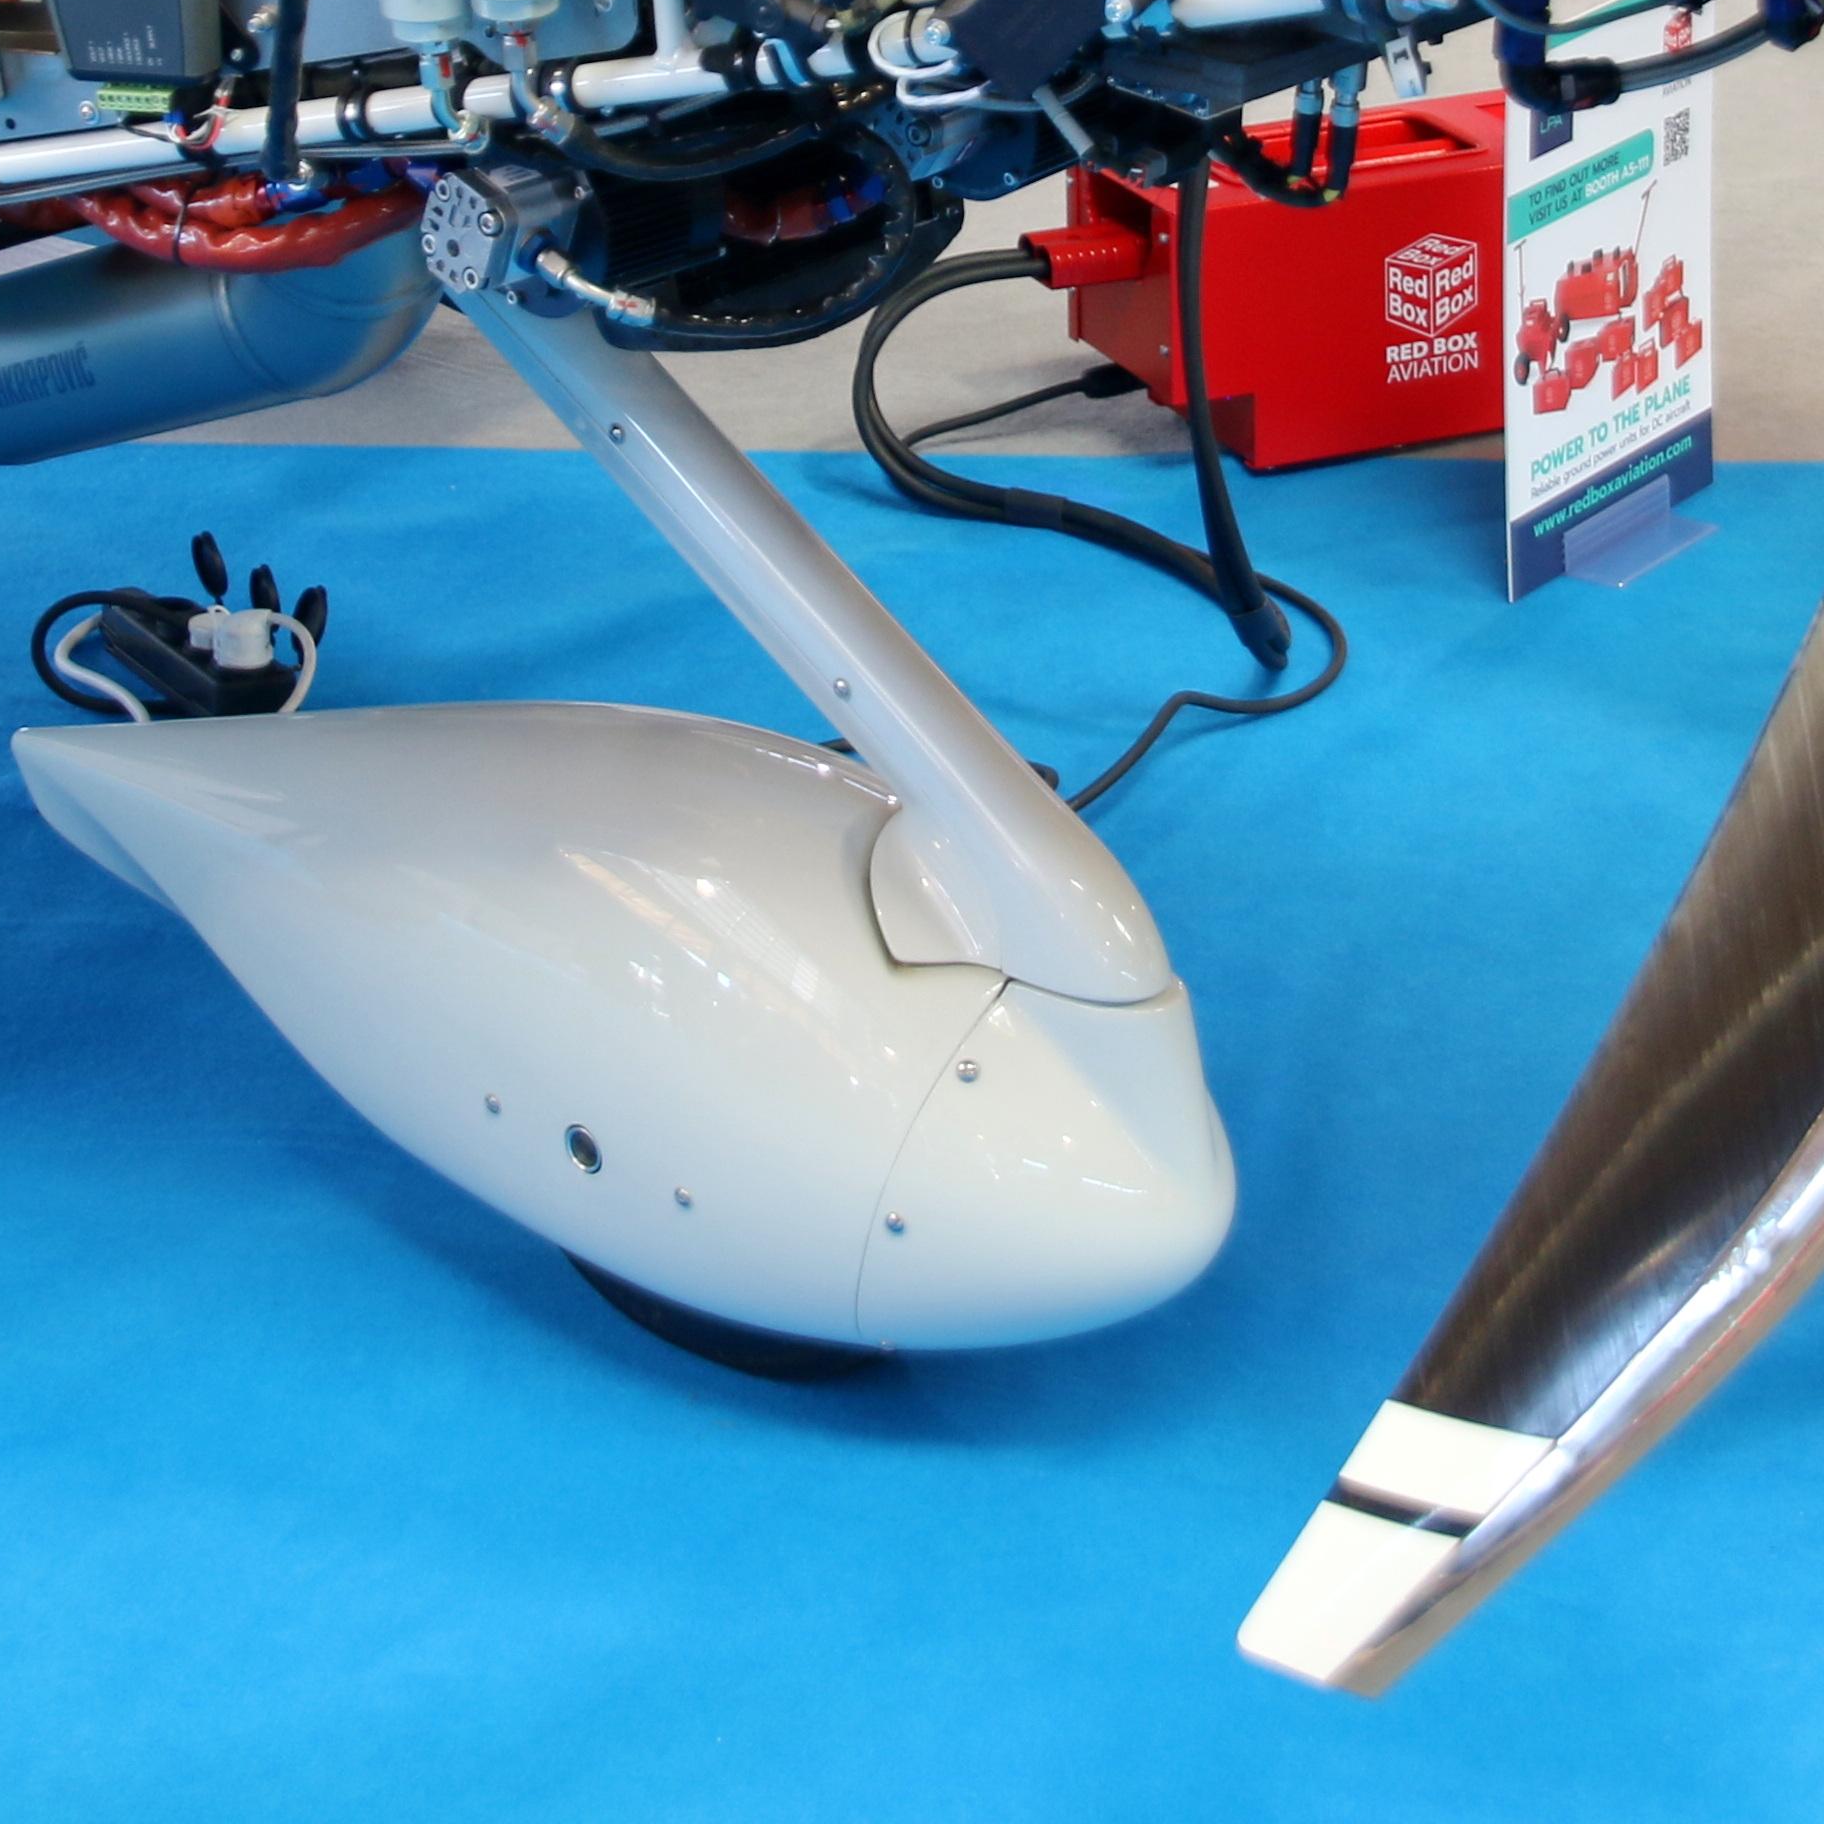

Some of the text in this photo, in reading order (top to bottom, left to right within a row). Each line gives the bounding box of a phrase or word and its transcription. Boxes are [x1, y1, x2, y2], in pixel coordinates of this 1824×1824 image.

[1528, 203, 1553, 226] VISIT
[1555, 195, 1569, 213] US
[1571, 187, 1583, 205] AT
[1584, 169, 1620, 198] BOOTH
[1529, 151, 1621, 207] TO FIND OUT MORE
[1396, 248, 1443, 265] Box
[1415, 238, 1467, 256] Red
[1388, 252, 1474, 300] Red Red
[1388, 284, 1474, 327] Box Box
[1385, 331, 1478, 364] RED BOX
[1386, 349, 1479, 385] AVIATION
[1530, 374, 1692, 481] POWER TO THE PLANE
[1530, 479, 1562, 500] Reliable
[1562, 461, 1593, 488] ground
[1593, 445, 1618, 468] power
[1619, 433, 1639, 449] units
[1640, 424, 1651, 437] for
[1665, 398, 1692, 424] aircraft
[1533, 434, 1694, 538] www.redboxaviation.com
